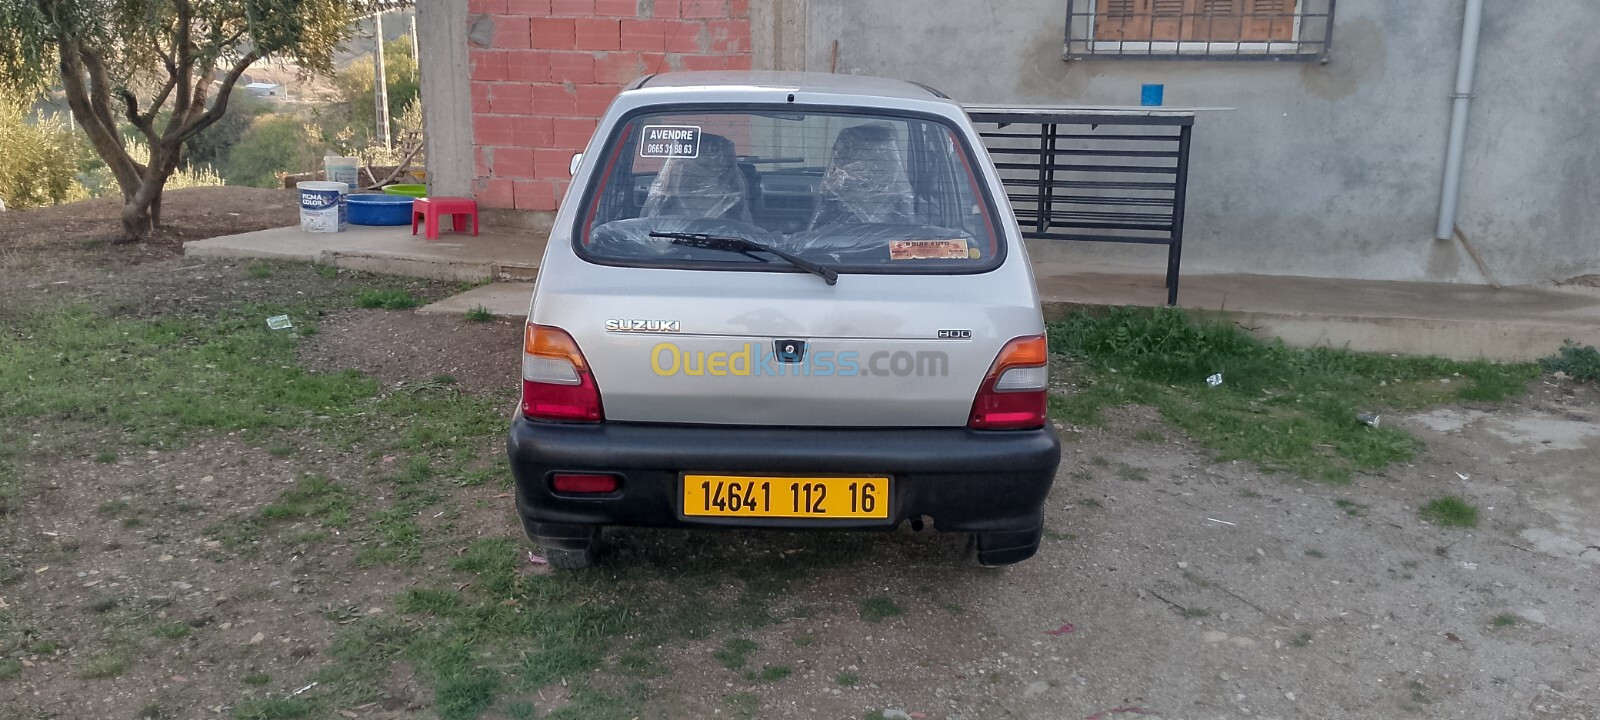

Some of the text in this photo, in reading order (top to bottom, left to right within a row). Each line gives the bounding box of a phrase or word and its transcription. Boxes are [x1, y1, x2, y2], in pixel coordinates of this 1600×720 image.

[650, 129, 694, 140] AVENDRE
[647, 143, 664, 154] 0665
[683, 143, 692, 155] 63
[605, 319, 681, 332] SUZUKI
[938, 330, 972, 338] 800
[701, 481, 876, 513] 14641 112 16
